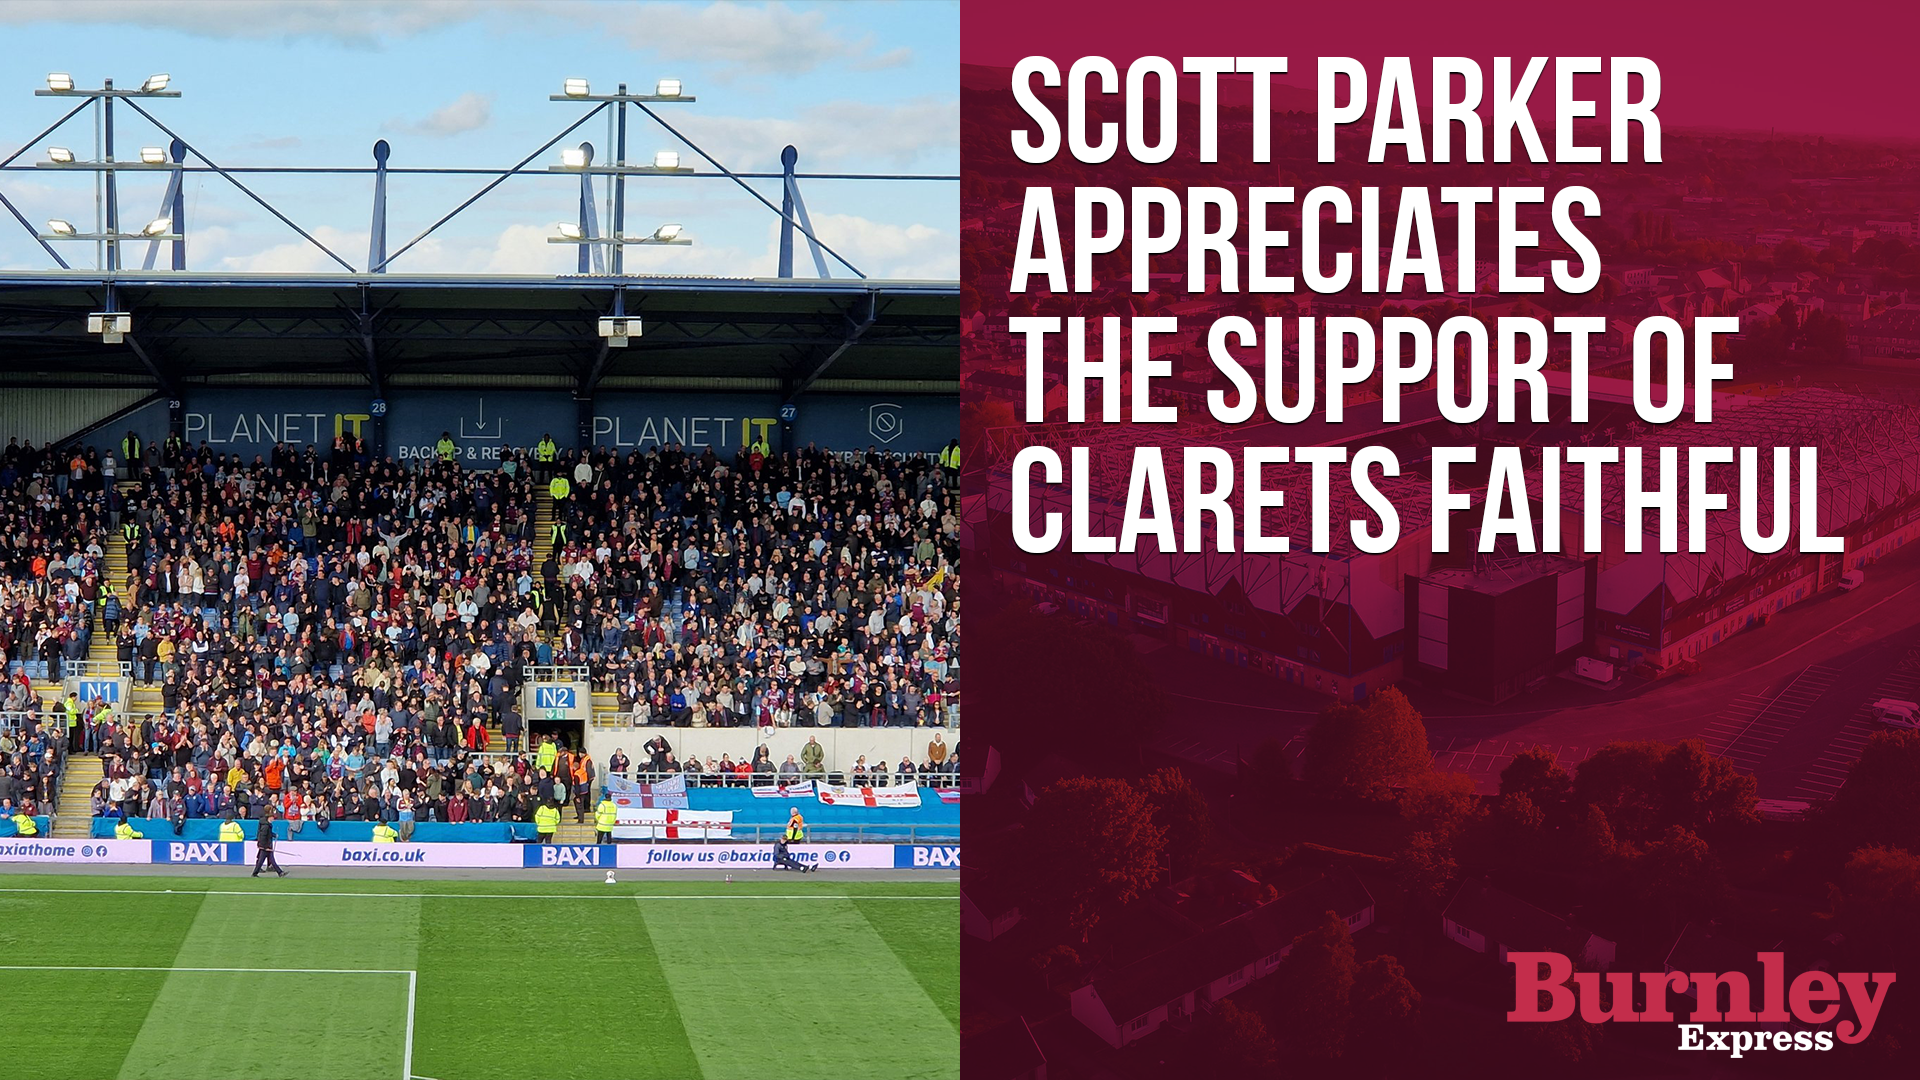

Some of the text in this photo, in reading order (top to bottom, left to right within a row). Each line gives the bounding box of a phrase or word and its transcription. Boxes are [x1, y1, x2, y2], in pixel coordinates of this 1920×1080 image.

[169, 400, 181, 409] 29
[371, 402, 387, 413] 28
[781, 407, 797, 418] 27
[185, 413, 370, 443] PLANET IT
[592, 416, 777, 447] PLANET IT
[399, 446, 463, 460] BACKP
[466, 447, 477, 460] &
[87, 682, 111, 702] N1
[543, 688, 569, 707] N2
[169, 842, 228, 862] BAXI
[341, 847, 426, 862] baxi.co.uk
[541, 846, 600, 866] BAXI
[646, 849, 819, 864] follow us @baxiaome
[912, 846, 960, 867] BAX
